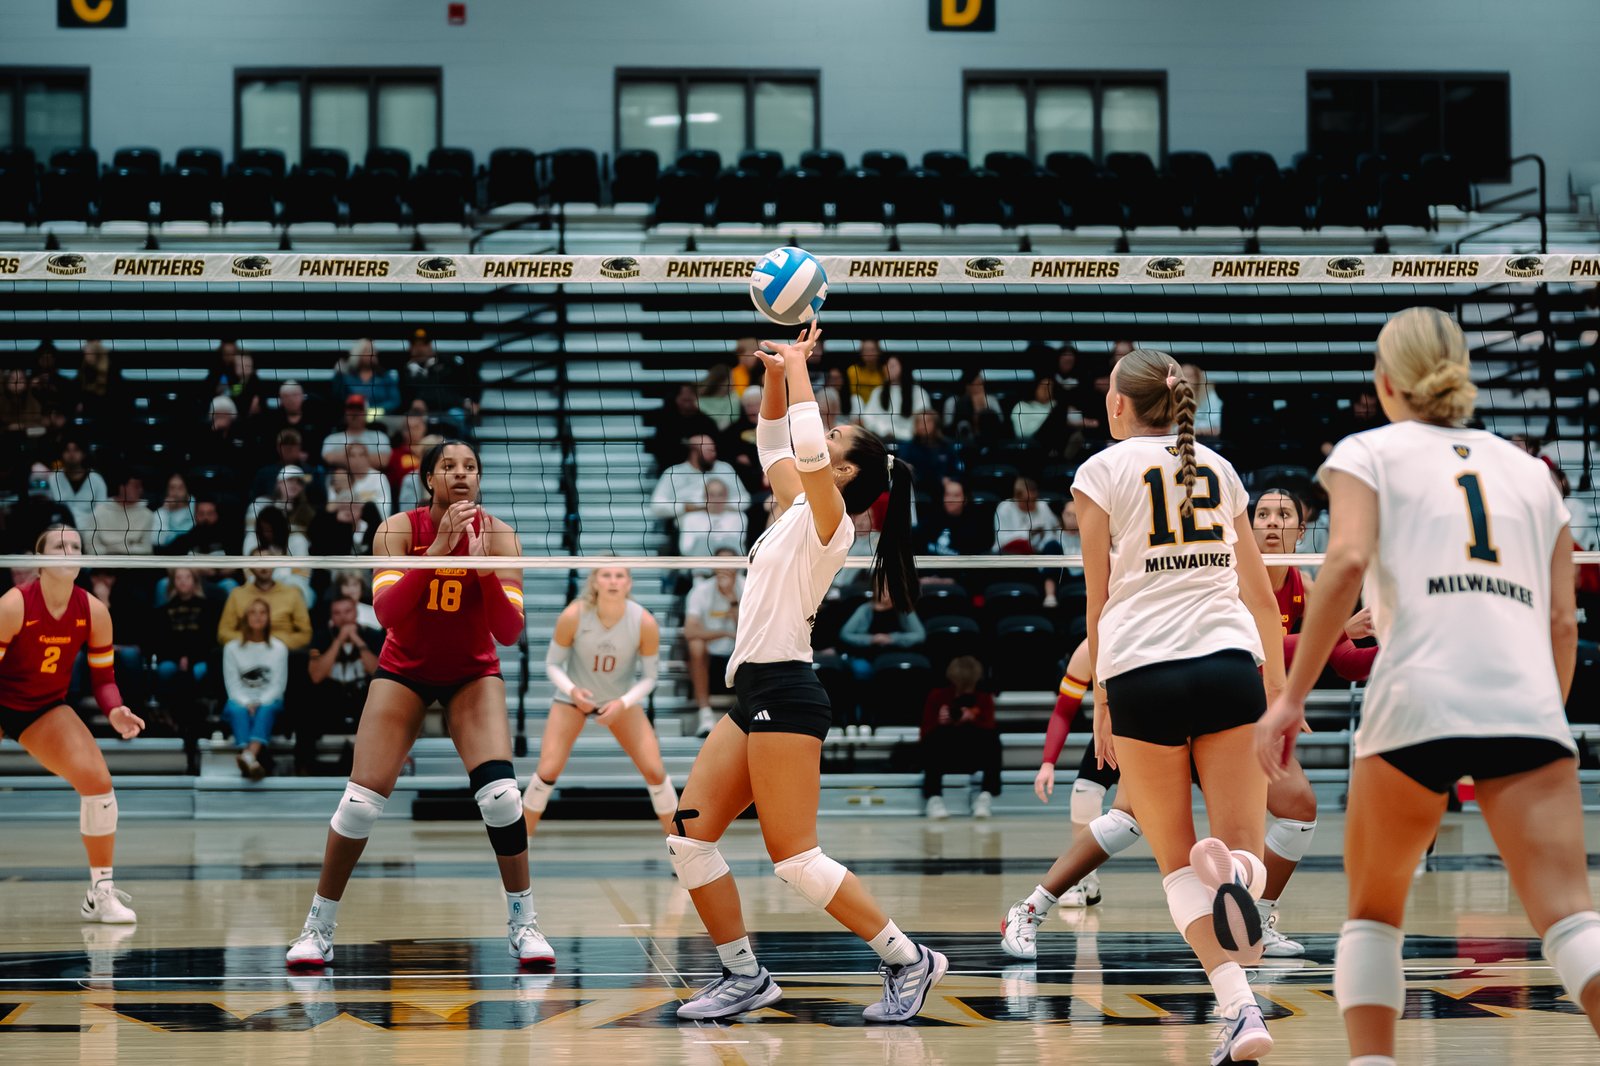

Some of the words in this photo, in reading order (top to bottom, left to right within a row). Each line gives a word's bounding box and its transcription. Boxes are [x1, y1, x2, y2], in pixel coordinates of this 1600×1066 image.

[46, 265, 87, 276] MILWAUKEE
[113, 258, 205, 277] PANTHERS
[231, 266, 273, 278] MILWAUKEE
[298, 259, 390, 277] PANTHERS
[416, 268, 457, 279] MILWAUKEE
[483, 260, 574, 278] PANTHERS
[600, 268, 641, 279] MILWAUKEE
[666, 260, 756, 278] PANTHERS
[848, 260, 939, 278] PANTHERS
[964, 268, 1005, 279] MILWAUKEE
[1030, 260, 1120, 278] PANTHERS
[1145, 268, 1186, 279] MILWAUKEE
[1211, 259, 1301, 277] PANTHERS
[1325, 268, 1366, 279] MILWAUKEE
[1391, 259, 1480, 277] PANTHERS
[1504, 267, 1545, 278] MILWAUKEE
[1142, 465, 1226, 549] 12
[1454, 469, 1502, 567] 1
[1145, 553, 1231, 573] MILWAUKEE
[427, 579, 463, 612] 18
[1427, 573, 1534, 610] MILWAUKEE
[40, 646, 61, 674] 2
[592, 655, 616, 673] 10
